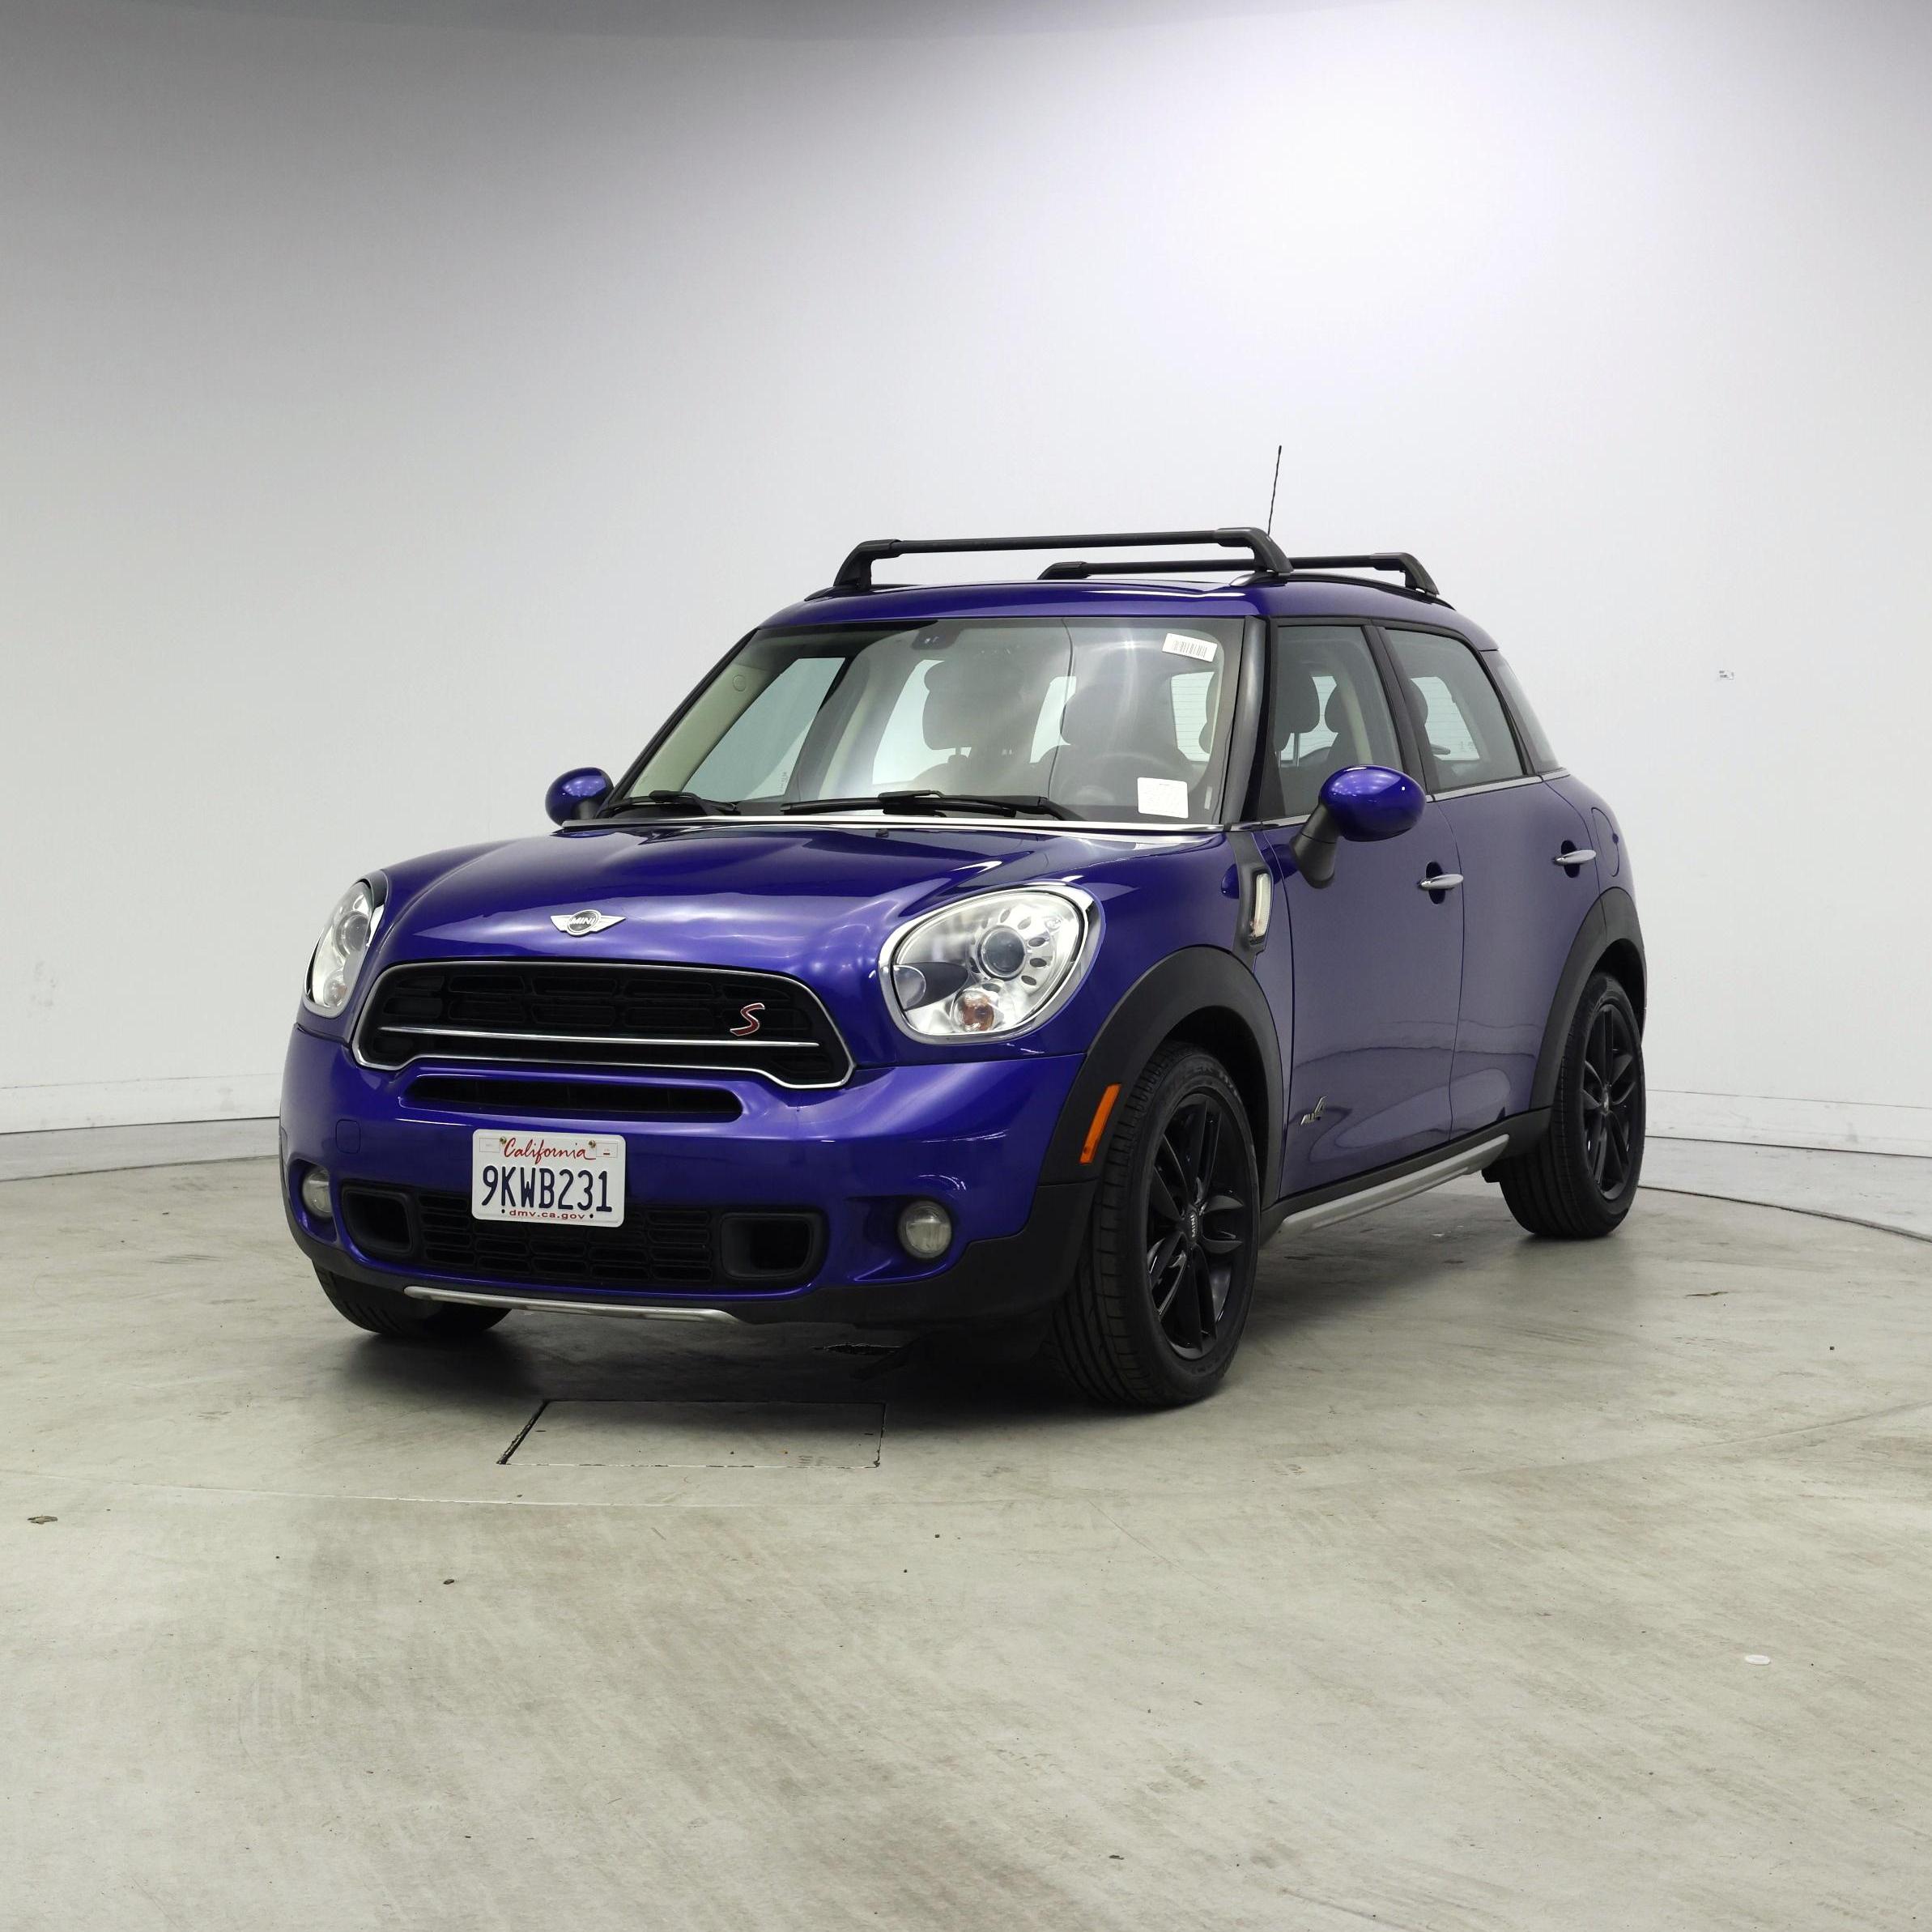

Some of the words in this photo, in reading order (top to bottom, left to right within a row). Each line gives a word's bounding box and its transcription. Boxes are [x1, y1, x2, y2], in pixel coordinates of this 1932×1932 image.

[571, 917, 596, 925] MINI
[730, 1002, 765, 1036] S
[504, 1137, 596, 1164] California
[482, 1165, 613, 1212] 9KWB231
[509, 1209, 585, 1220] dmv.ca.gov
